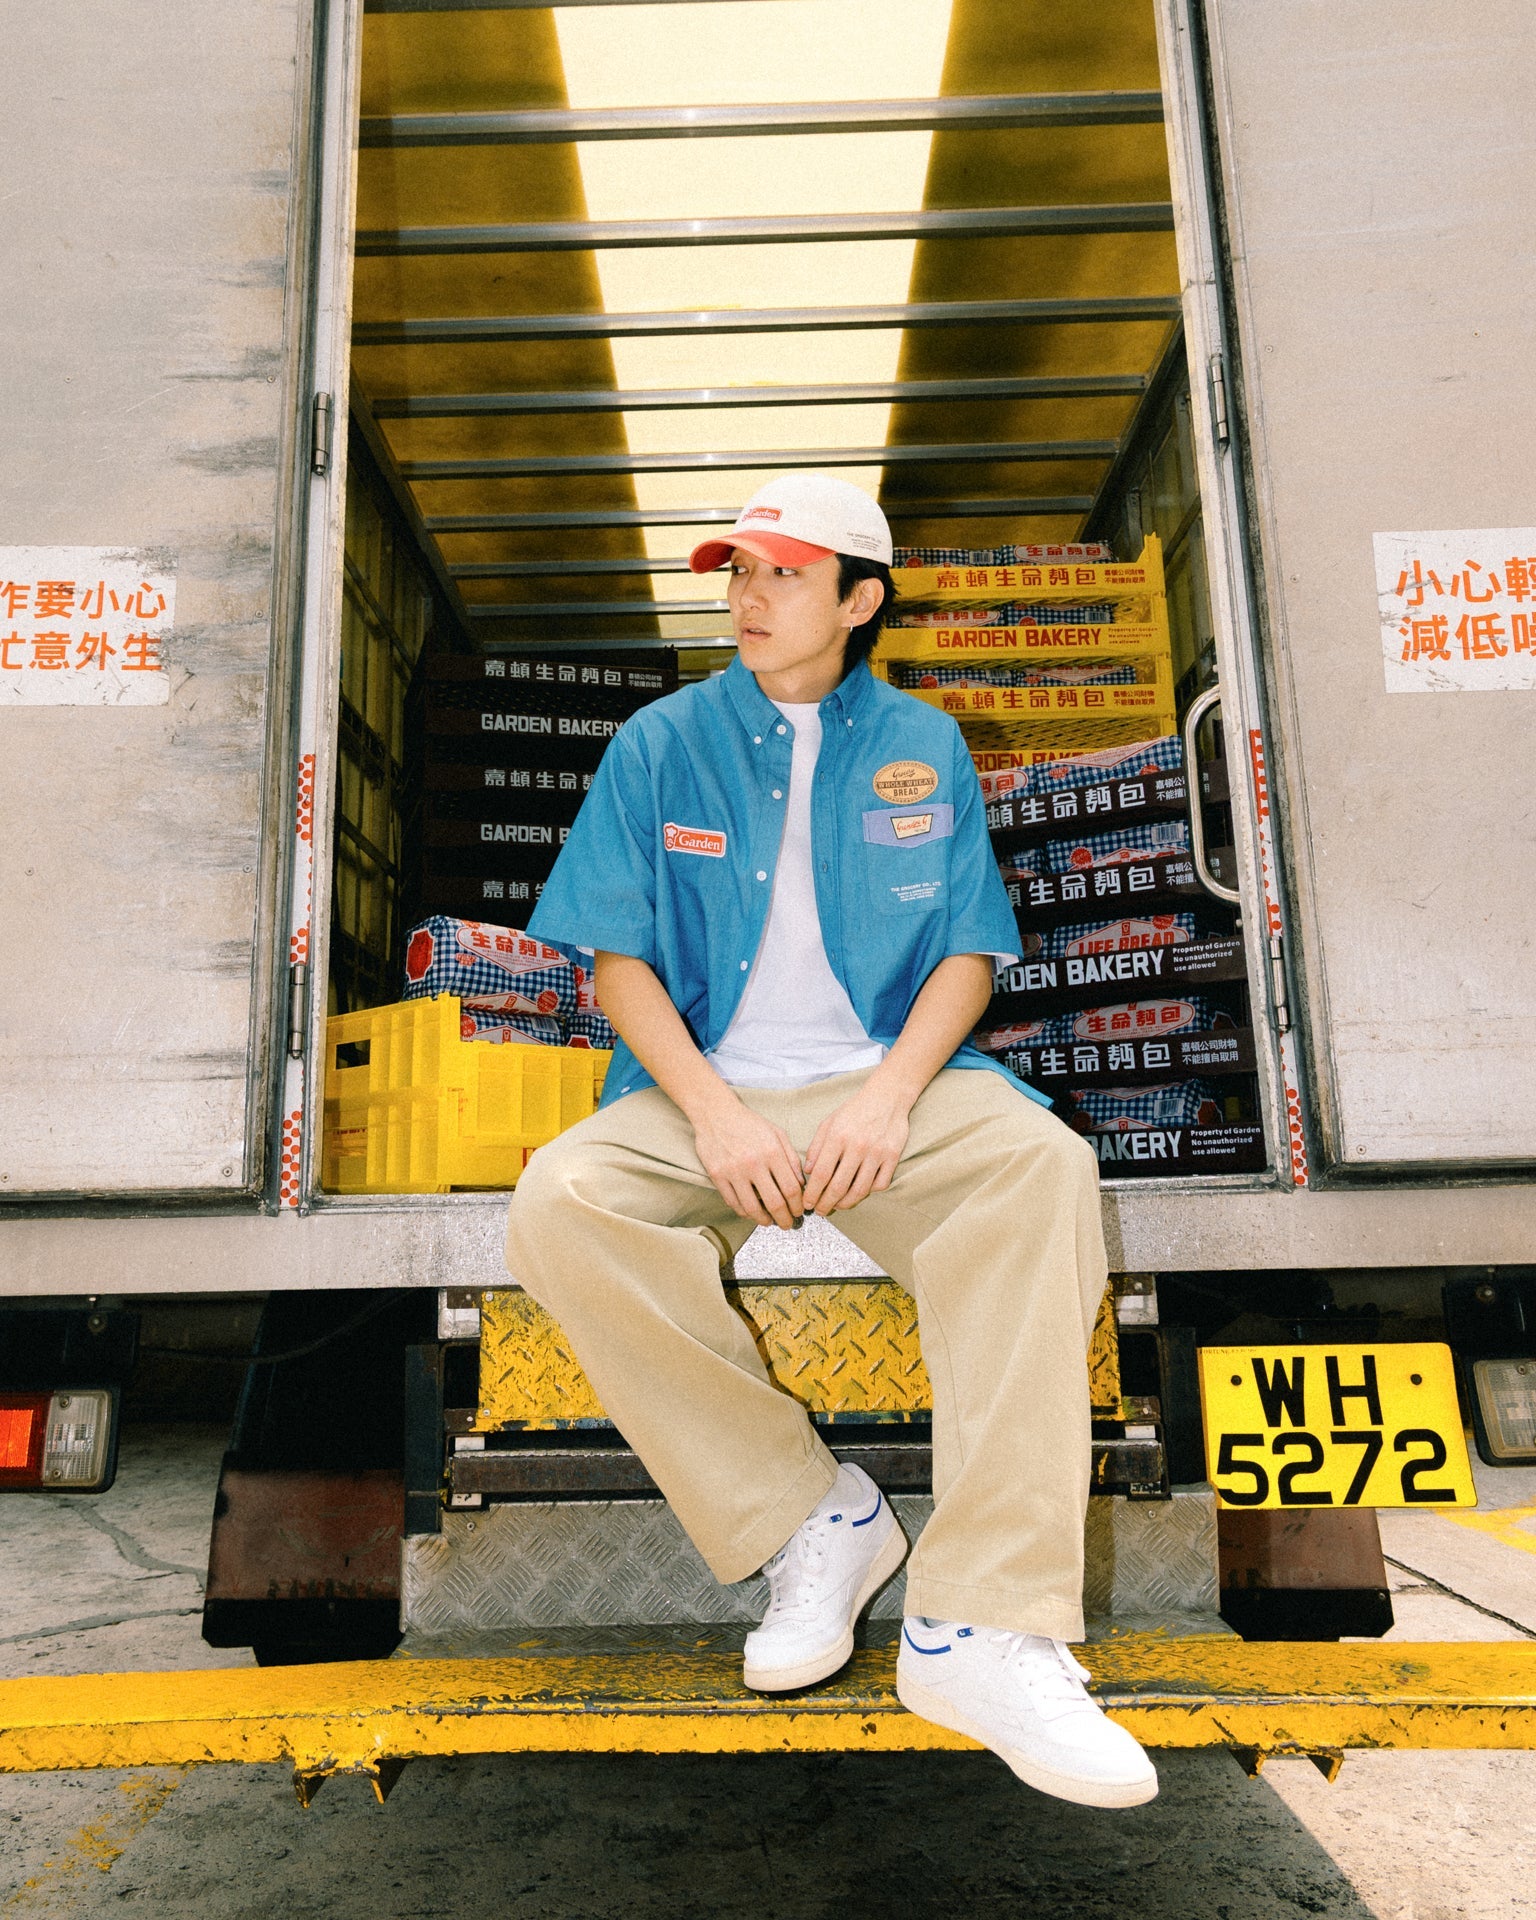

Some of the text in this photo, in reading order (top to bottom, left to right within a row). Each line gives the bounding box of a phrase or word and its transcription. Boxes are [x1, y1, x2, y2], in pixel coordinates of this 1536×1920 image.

[750, 508, 778, 520] Garden
[936, 627, 1101, 648] GARDEN BAKERY
[481, 713, 624, 737] GARDEN BAKERY
[971, 752, 1024, 772] RDEN
[877, 778, 934, 789] WHOLE WHEAT
[893, 787, 919, 797] BREAD
[480, 824, 552, 844] GARDEN
[678, 834, 720, 850] Garden
[1173, 945, 1204, 954] Property
[1214, 941, 1240, 949] Garden
[1185, 950, 1233, 961] unauthorized
[992, 949, 1164, 994] RDEN BAKERY
[1188, 961, 1216, 970] allowed
[1190, 1129, 1223, 1137] Property
[1233, 1127, 1261, 1135] Garden
[1203, 1136, 1253, 1145] unauthorized
[1206, 1146, 1236, 1155] allowed
[1251, 1355, 1384, 1428] WH
[1217, 1429, 1457, 1506] 5272
